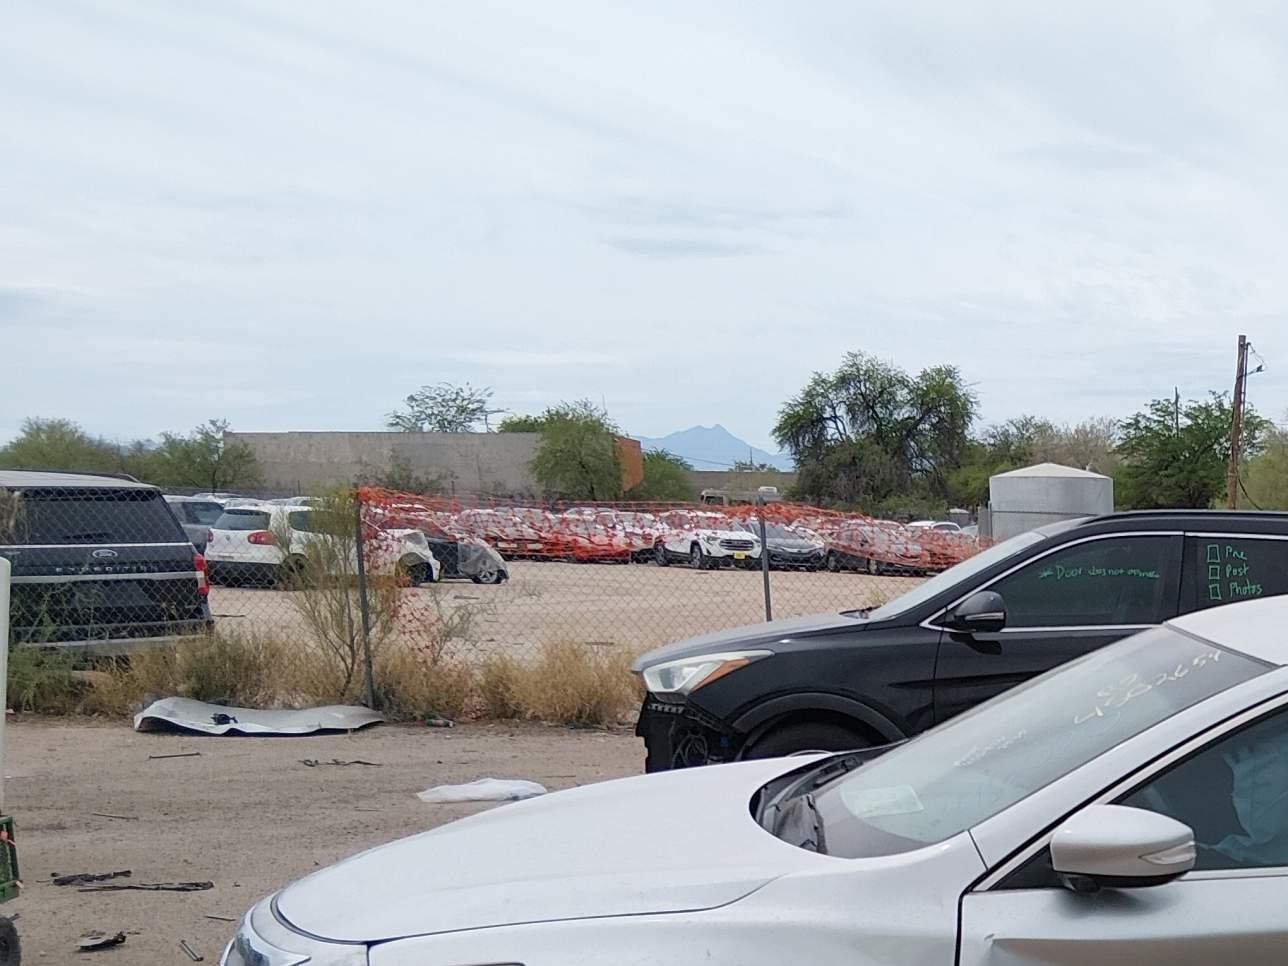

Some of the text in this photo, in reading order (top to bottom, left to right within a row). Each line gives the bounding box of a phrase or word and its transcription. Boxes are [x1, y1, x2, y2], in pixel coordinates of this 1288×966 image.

[1055, 565, 1082, 579] Door
[1225, 562, 1249, 577] Post
[1229, 579, 1262, 597] Photos
